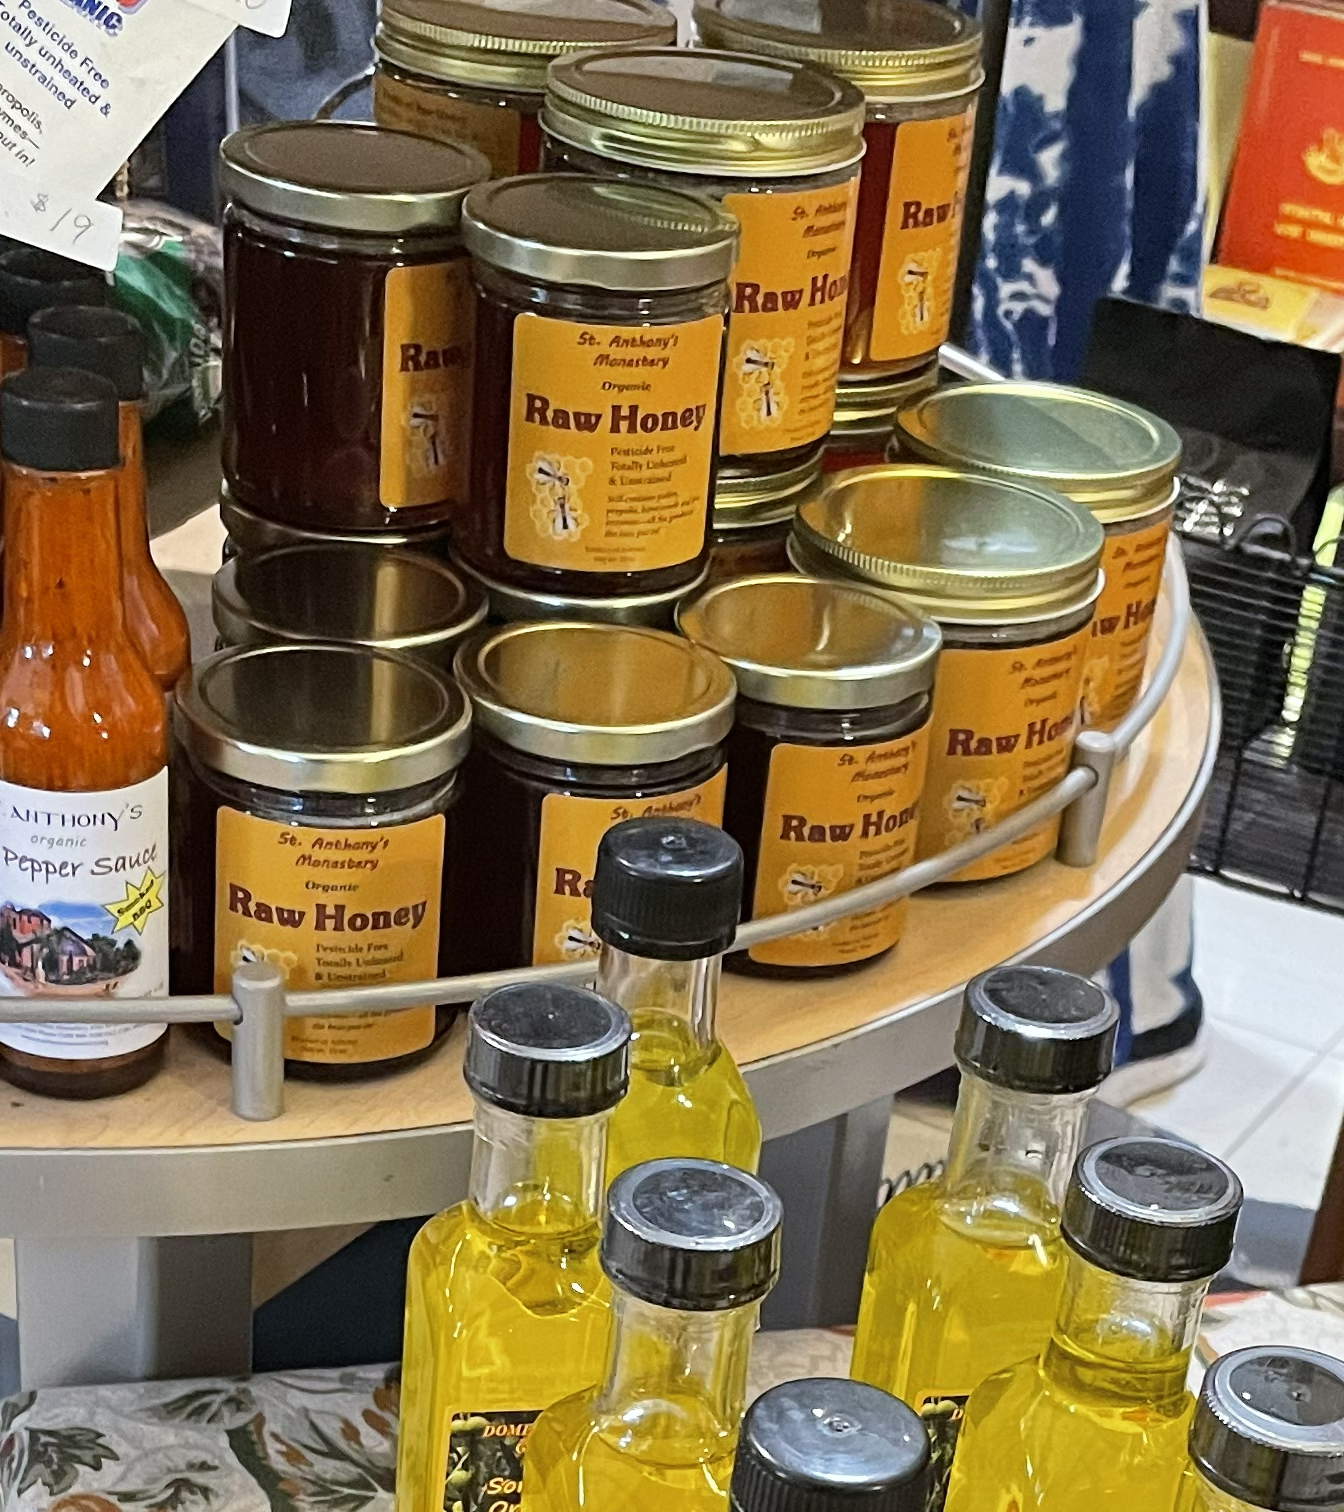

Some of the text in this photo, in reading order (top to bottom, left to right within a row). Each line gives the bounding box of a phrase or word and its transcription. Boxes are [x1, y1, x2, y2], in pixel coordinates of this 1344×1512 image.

[18, 0, 110, 90] Pesticide Free
[4, 41, 77, 110] unstrained
[38, 46, 101, 105] unheated
[100, 103, 112, 118] &
[16, 146, 36, 167] in!
[732, 273, 848, 314] Raw Hon
[577, 331, 679, 348] St. Anthony's
[593, 354, 670, 369] Monastery
[600, 381, 652, 392] Organic
[524, 392, 707, 434] Raw Honey
[946, 709, 1077, 757] Raw Hon
[11, 803, 143, 832] ANTHONY'S
[779, 801, 918, 843] Raw Hon
[30, 834, 87, 849] organic
[277, 831, 390, 854] St. Anthony's
[2, 846, 84, 885] Pepper
[90, 842, 158, 876] Sauce
[295, 853, 379, 871] Monastery
[117, 879, 154, 916] Smoked
[305, 880, 359, 893] Organic
[132, 899, 152, 922] BBQ
[228, 882, 428, 932] Raw Honey
